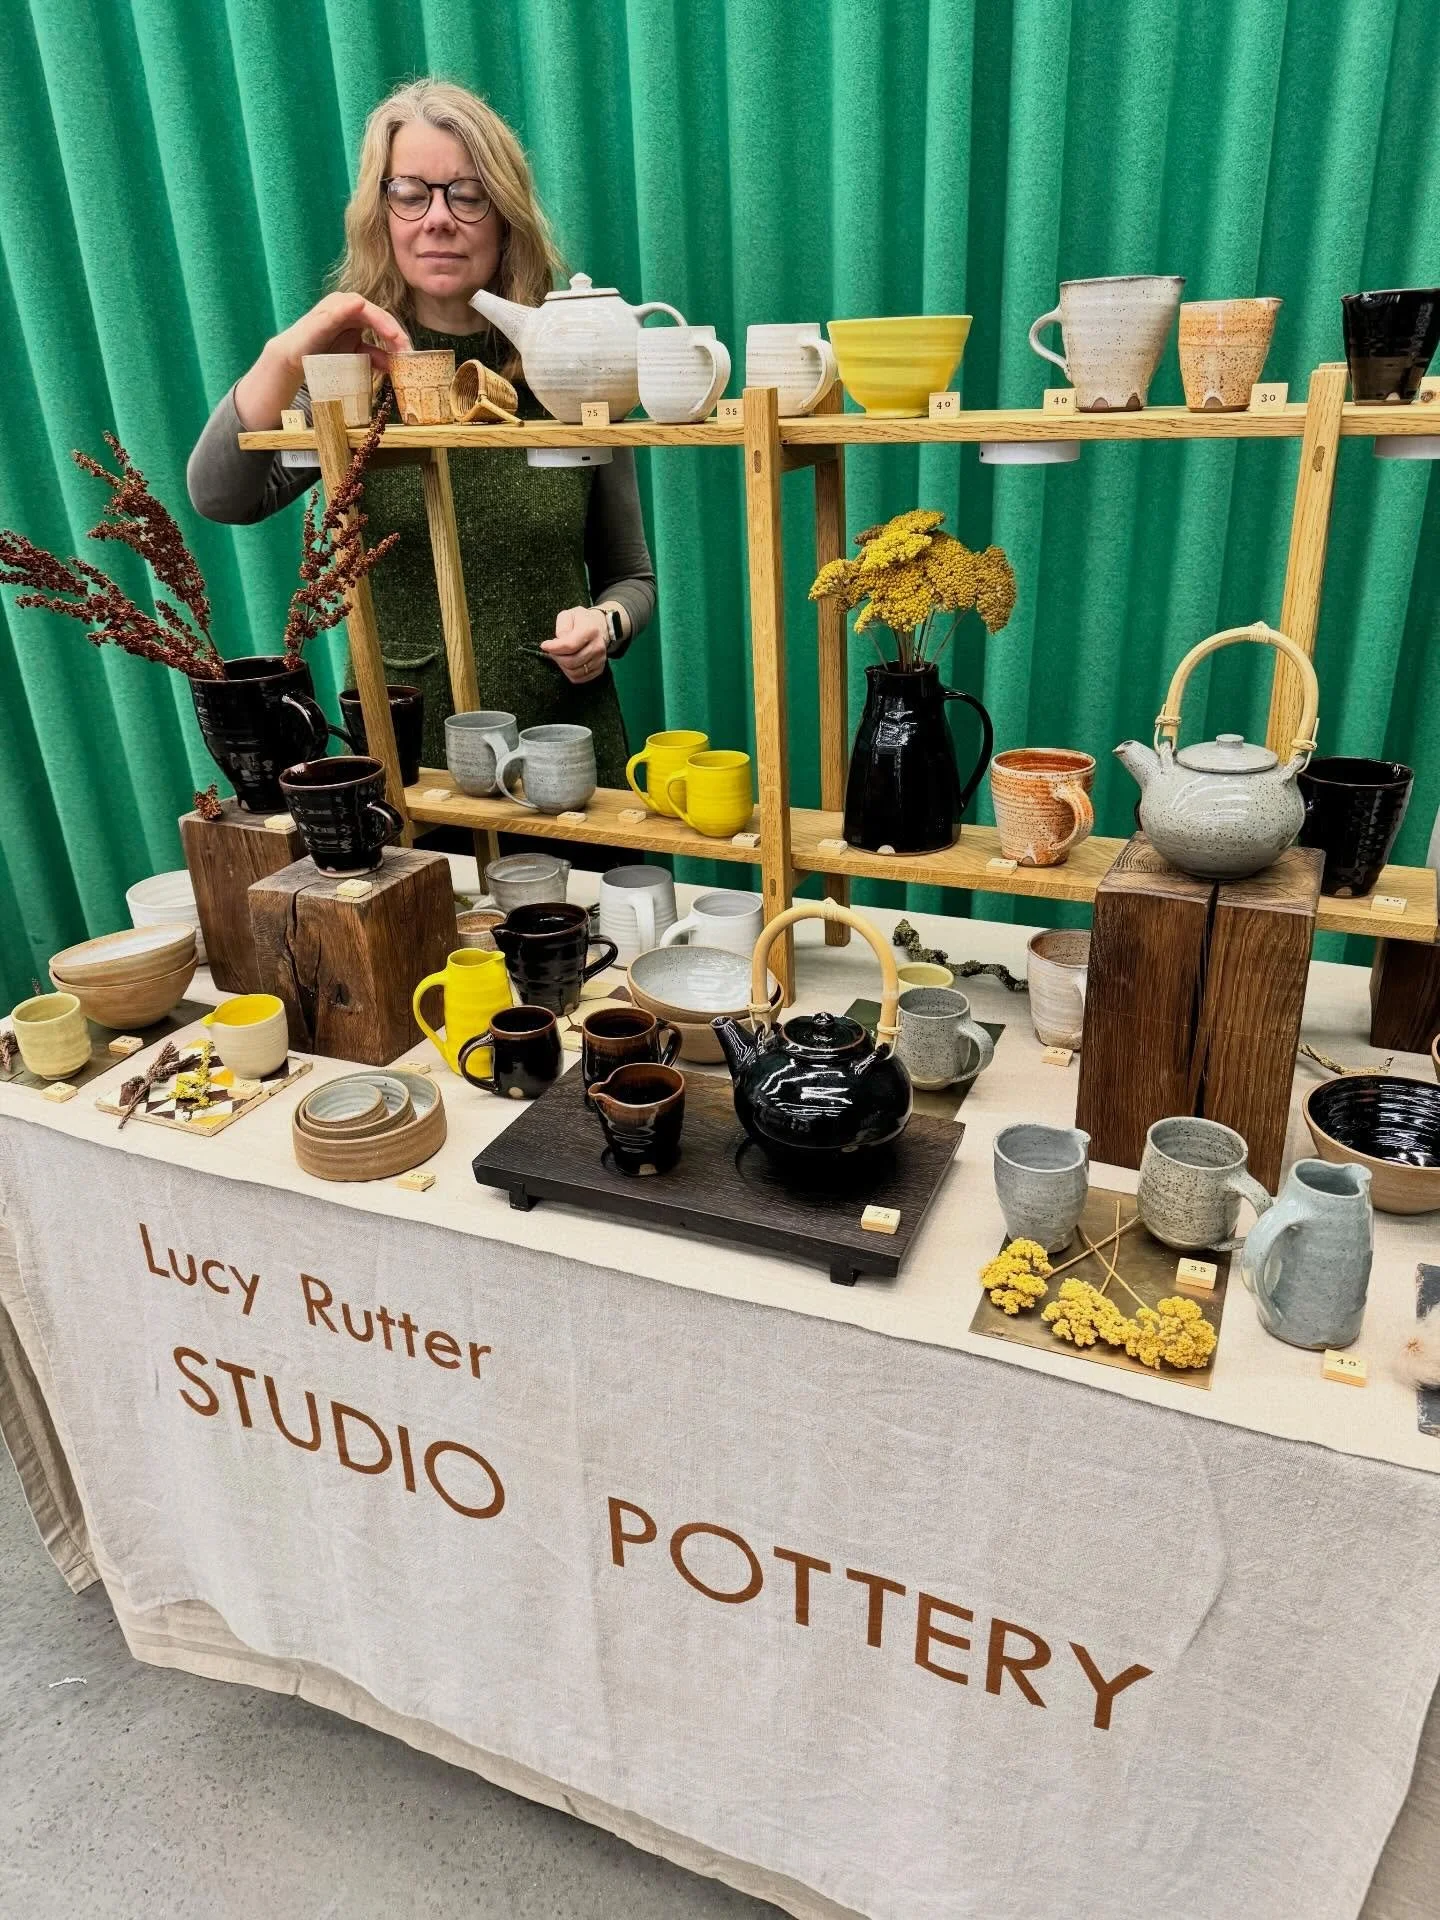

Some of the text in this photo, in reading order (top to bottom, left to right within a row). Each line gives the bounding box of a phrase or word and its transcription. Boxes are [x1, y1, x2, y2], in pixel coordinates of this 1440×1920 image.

[1053, 396, 1068, 404] 40
[1261, 393, 1276, 403] 30
[936, 401, 951, 410] 40
[587, 409, 598, 417] 75
[725, 407, 738, 416] 35
[139, 1222, 492, 1379] Lucy Rutter
[172, 1346, 1154, 1731] STUDIO POTTERY
